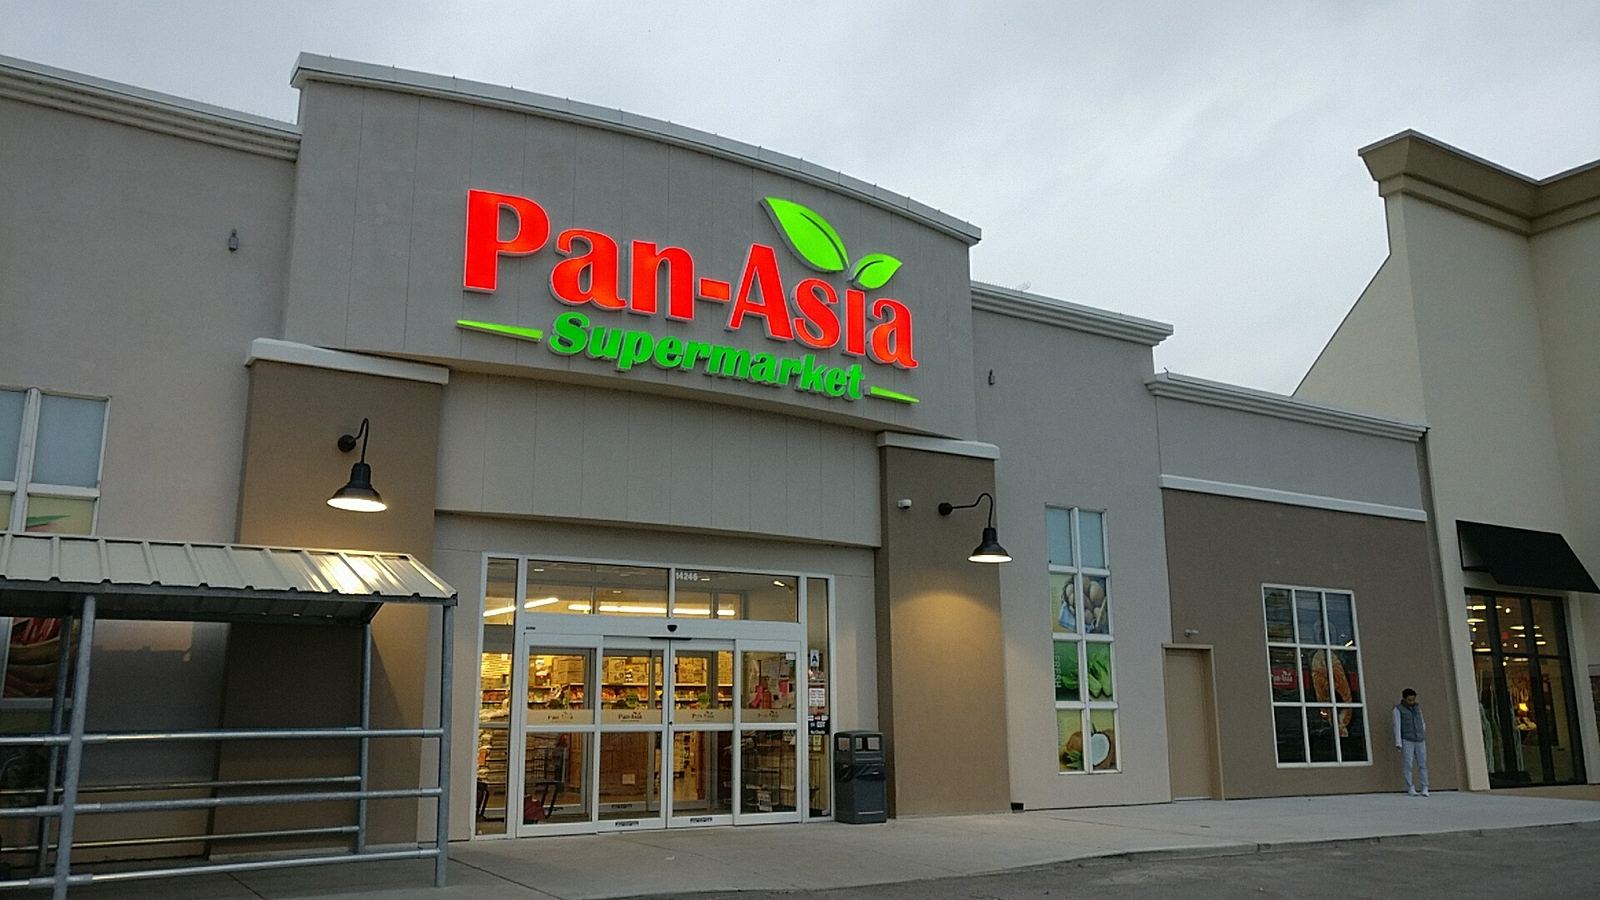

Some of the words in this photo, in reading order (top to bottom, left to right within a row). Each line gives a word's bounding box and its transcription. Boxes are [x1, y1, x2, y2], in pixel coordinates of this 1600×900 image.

[463, 189, 918, 369] Pan-Asia
[548, 311, 866, 400] Supermarket
[1053, 655, 1062, 688] FRESH
